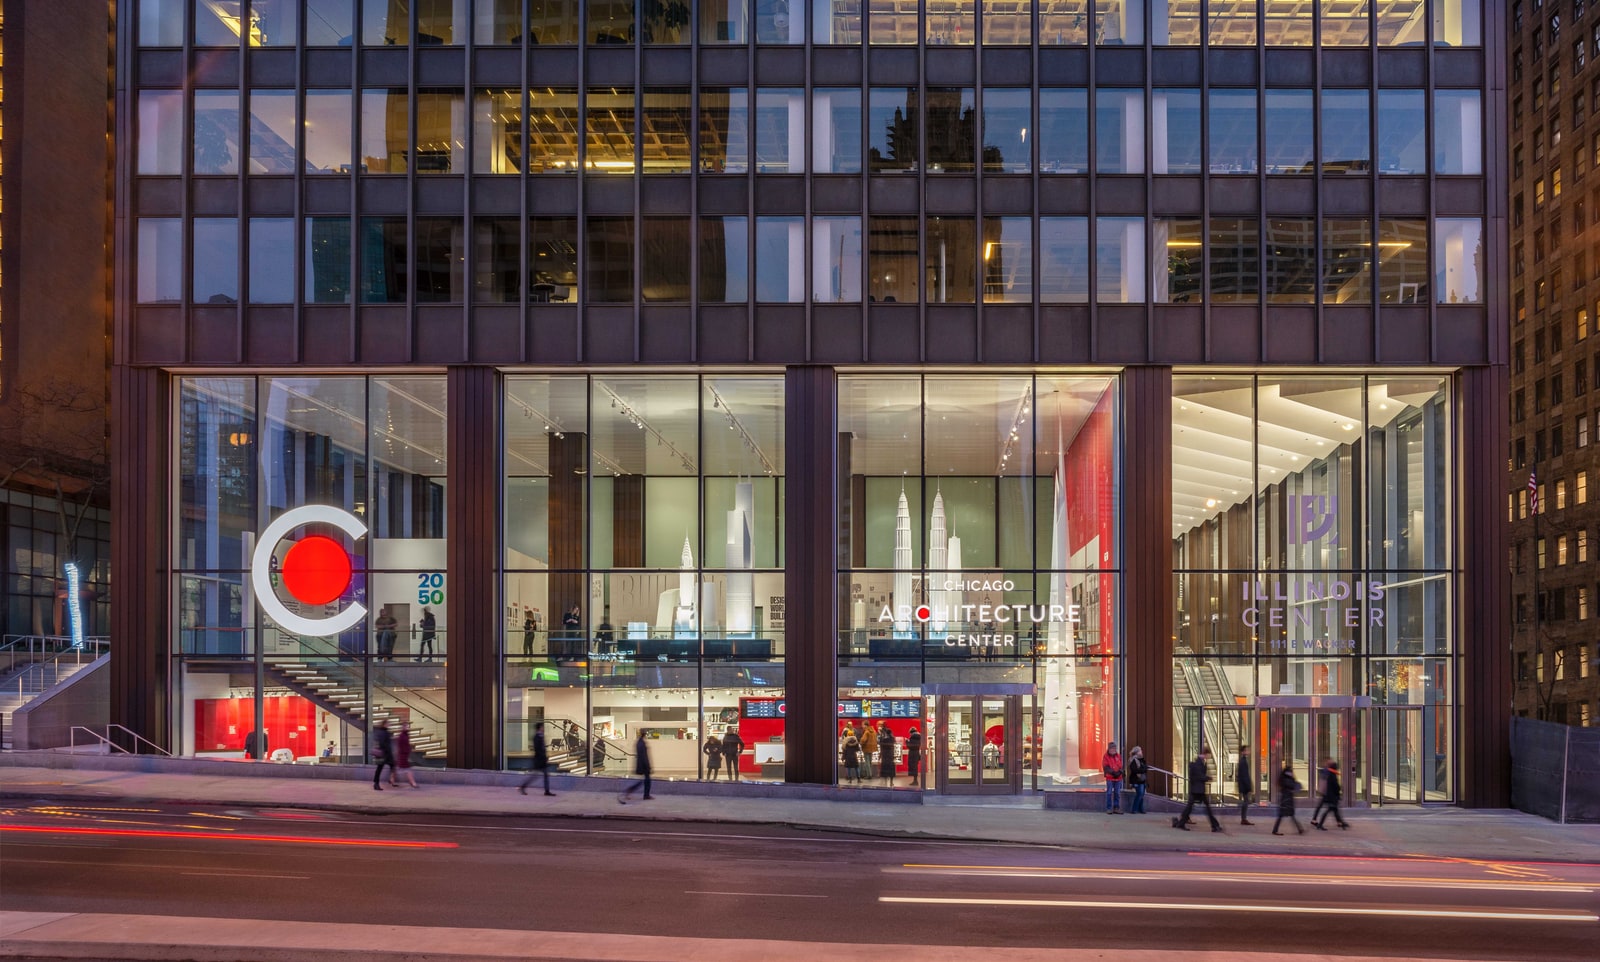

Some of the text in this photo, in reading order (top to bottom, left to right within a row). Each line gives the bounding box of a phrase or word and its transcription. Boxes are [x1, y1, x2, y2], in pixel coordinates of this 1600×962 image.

[418, 573, 444, 588] 20
[944, 580, 1015, 592] CHICAGO
[418, 590, 445, 605] 50
[1242, 581, 1384, 600] ILLINOIS
[878, 604, 1081, 623] ARCHITECTURE
[1242, 608, 1384, 627] CENTER
[944, 634, 1015, 647] CENTER
